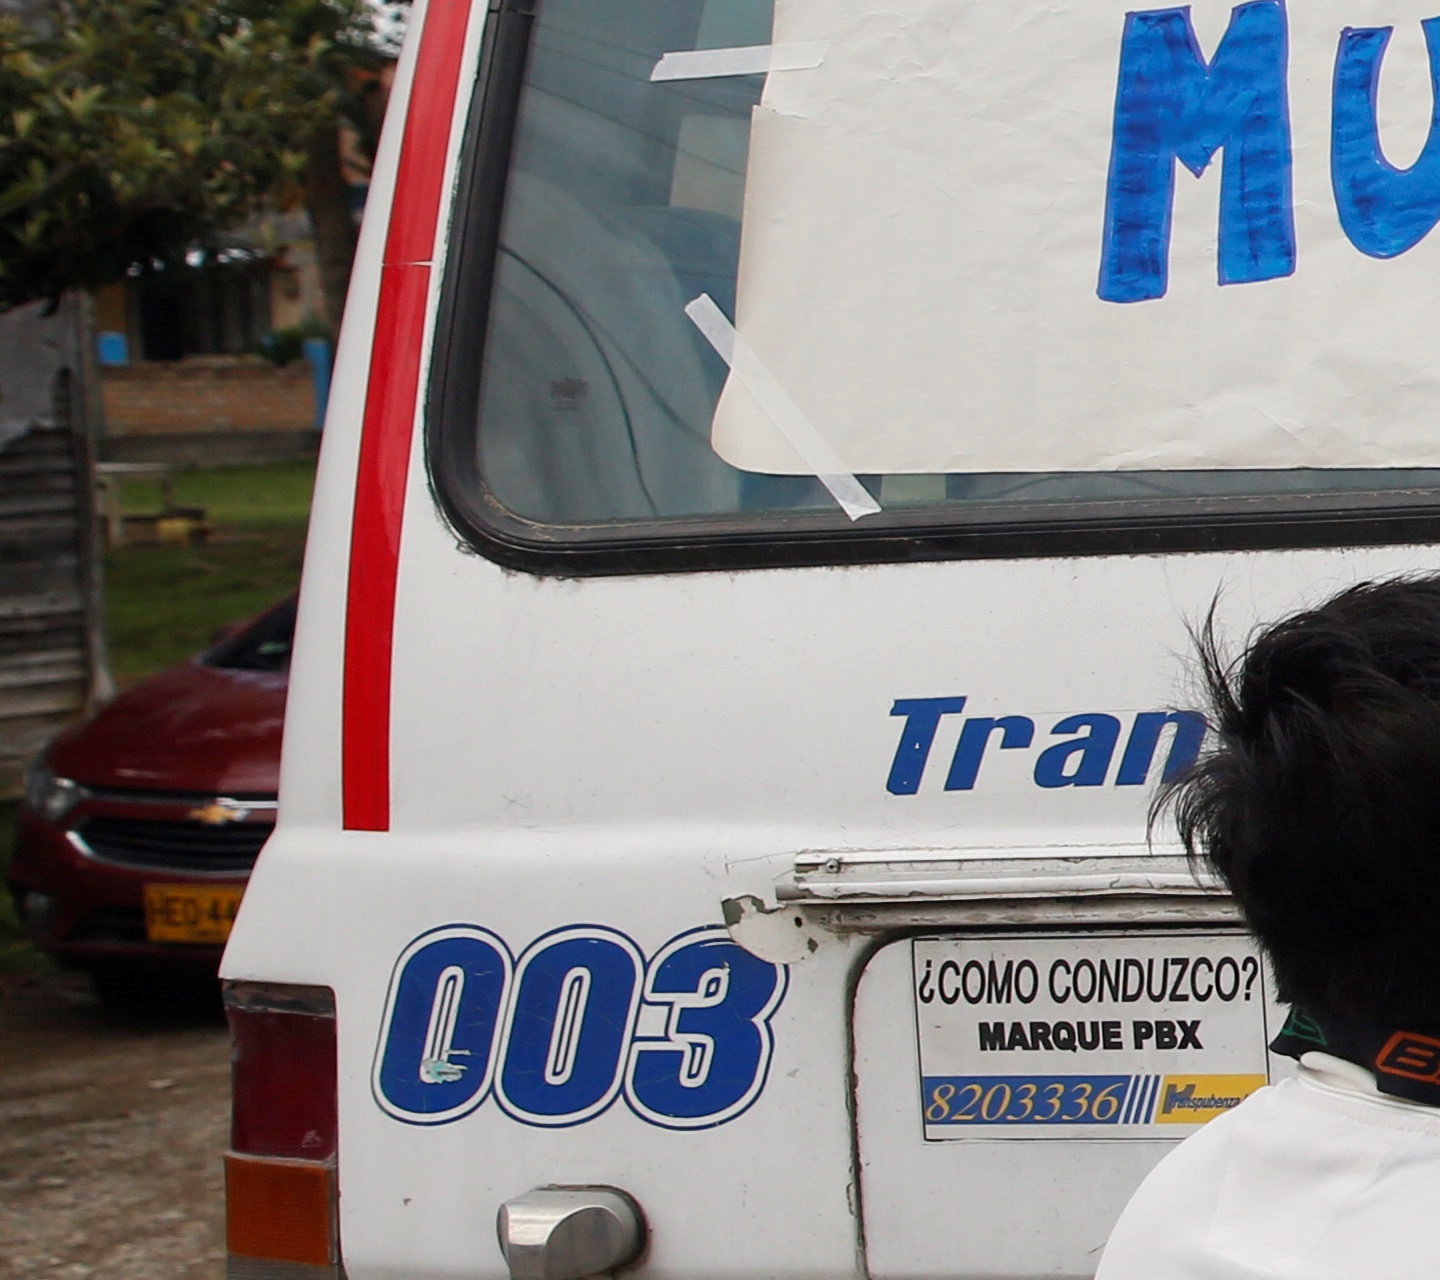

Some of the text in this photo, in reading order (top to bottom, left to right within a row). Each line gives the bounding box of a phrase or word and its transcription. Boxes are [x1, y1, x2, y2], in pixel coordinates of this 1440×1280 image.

[919, 956, 1259, 1005] ¿COMO CONDUZCO?
[371, 924, 789, 1131] 003
[978, 1019, 1204, 1052] MARQUE PBX
[925, 1082, 1125, 1121] 8203336
